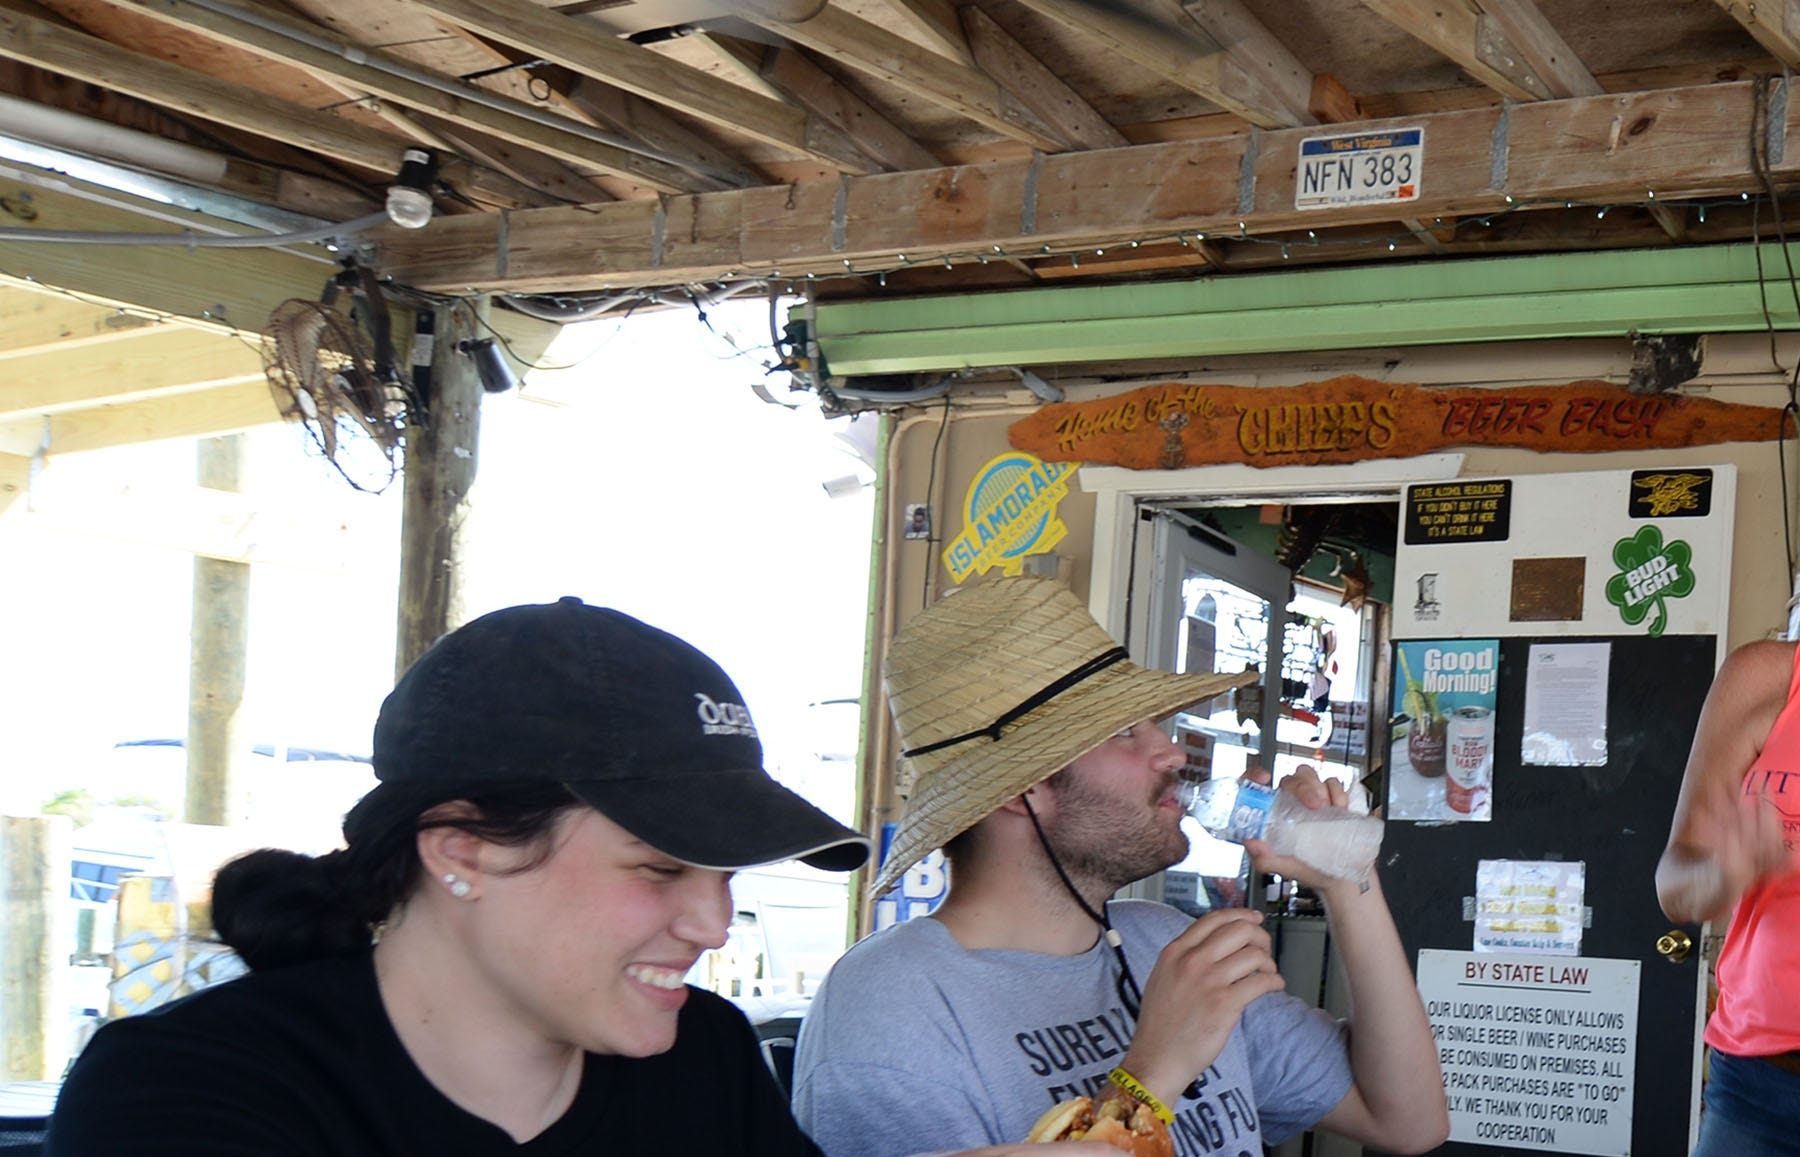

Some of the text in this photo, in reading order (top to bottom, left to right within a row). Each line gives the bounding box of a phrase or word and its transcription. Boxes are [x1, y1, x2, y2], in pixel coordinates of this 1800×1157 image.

[1304, 153, 1412, 193] NFN 383
[1056, 400, 1143, 452] Home
[1414, 487, 1433, 498] STATE
[1624, 563, 1682, 607] LIGHT
[1625, 555, 1667, 588] BUD
[1424, 647, 1494, 671] Good
[1422, 669, 1497, 695] Morning!
[1465, 960, 1589, 986] BY STATE LAW
[1427, 1000, 1625, 1031] OUR LIQUOR LICENSE ONLY ALLOWS
[1016, 1007, 1136, 1077] SURELY
[1430, 1024, 1448, 1041] OR
[1449, 1025, 1485, 1044] SINGLE
[1488, 1028, 1518, 1047] BEER
[1526, 1030, 1555, 1050] WINE
[1557, 1033, 1627, 1055] PURCHASES
[1440, 1048, 1625, 1079] BE CONSUMED ON PREMISES. ALL
[1450, 1072, 1479, 1091] PACK
[1481, 1076, 1549, 1098] PURCHASES
[1551, 1081, 1575, 1099] ARE
[1218, 1087, 1257, 1140] FU
[1465, 1097, 1608, 1126] WE THANK YOU FOR YOUR
[1476, 1121, 1556, 1145] COOPERATION
